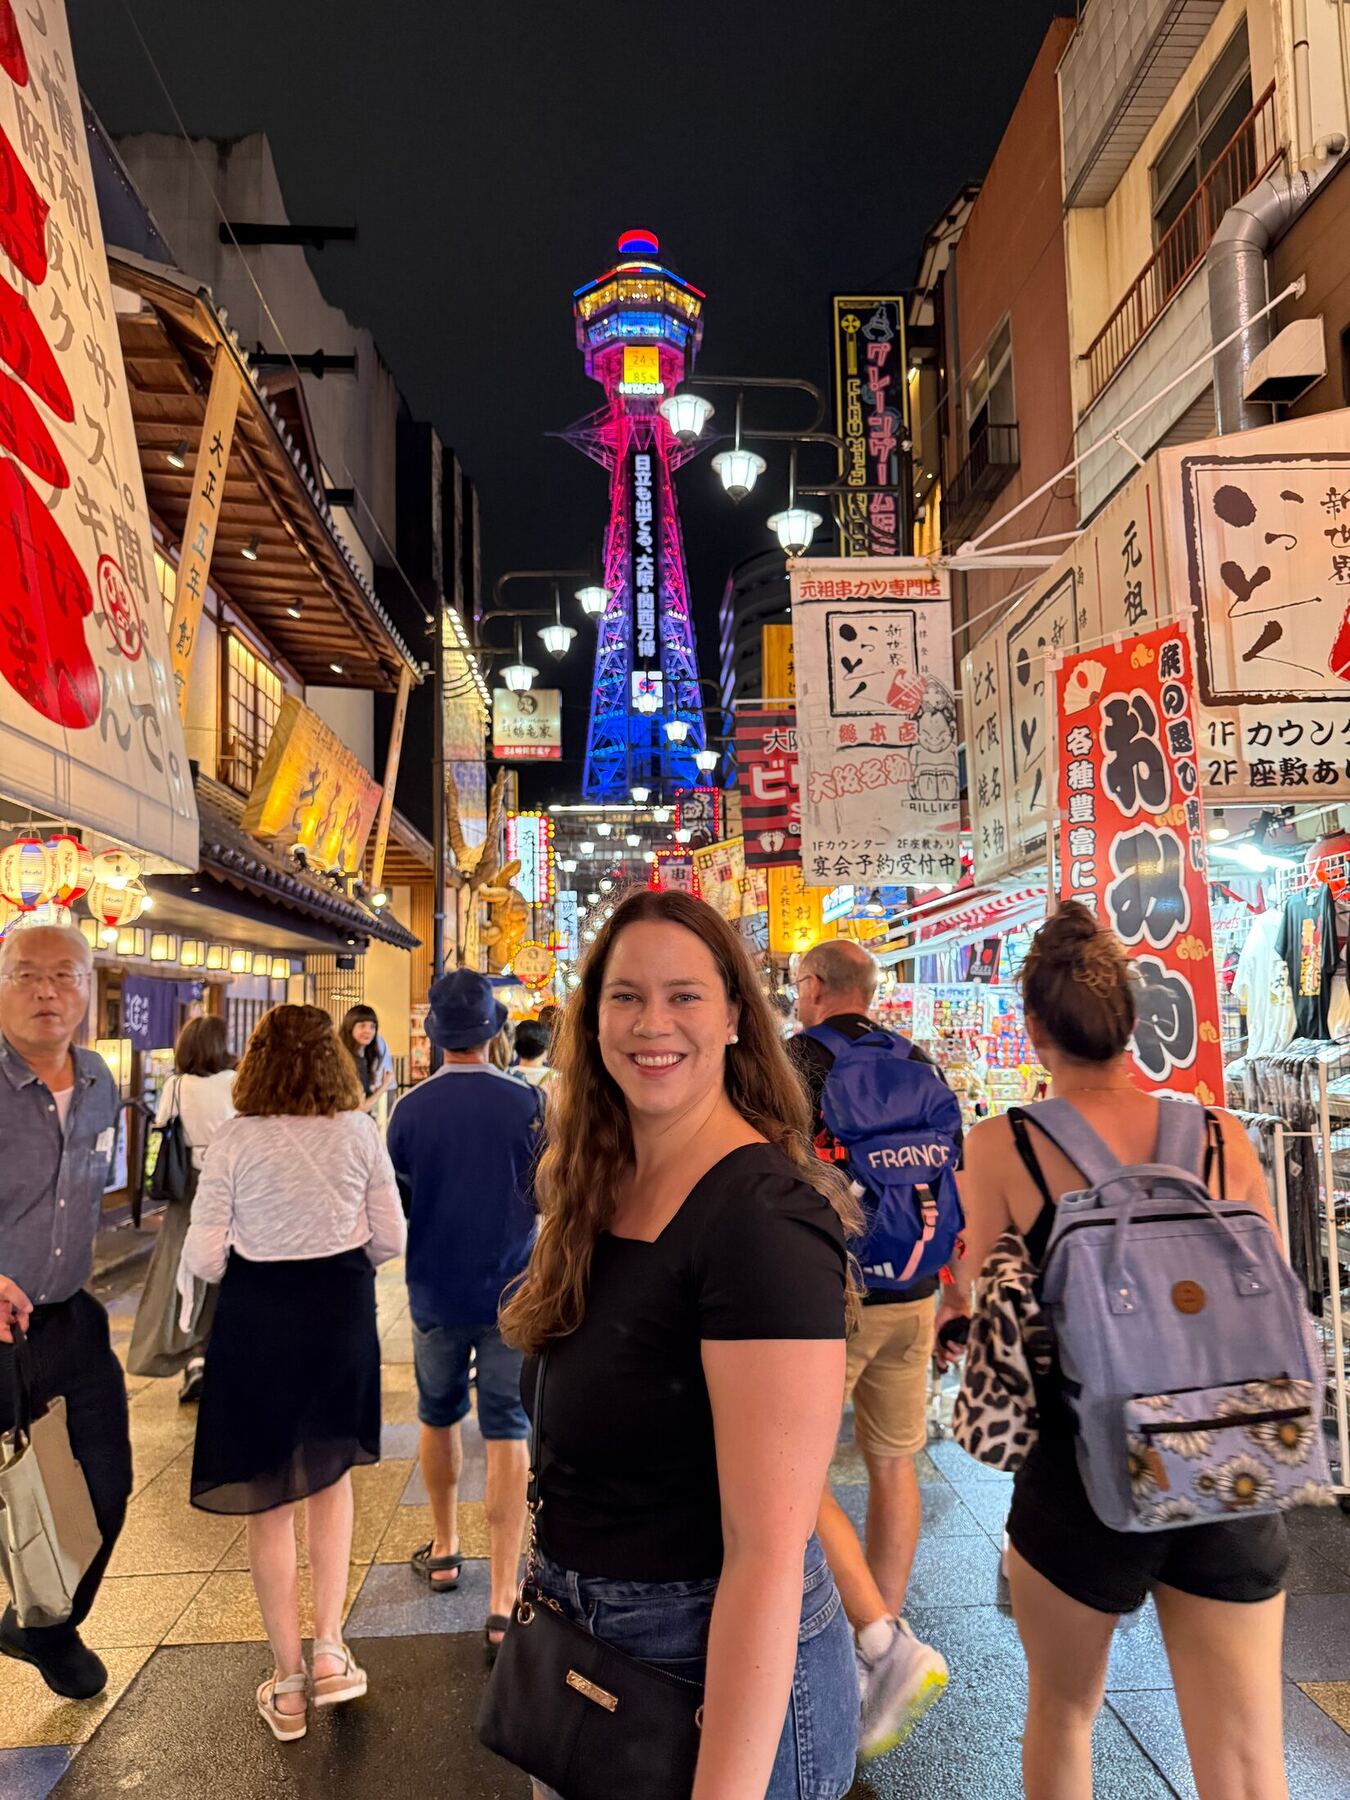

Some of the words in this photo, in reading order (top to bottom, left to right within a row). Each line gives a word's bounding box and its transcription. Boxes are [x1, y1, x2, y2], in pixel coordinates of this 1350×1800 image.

[800, 579, 941, 599] 元祖串カツ専門店
[1122, 520, 1147, 636] 元祖
[1208, 721, 1236, 747] 1F
[808, 753, 915, 804] 大阪名物
[1208, 760, 1239, 786] 2F
[811, 853, 957, 877] 宴会予約受付中
[1103, 692, 1197, 1090] おみや
[867, 1143, 950, 1169] FRANCE
